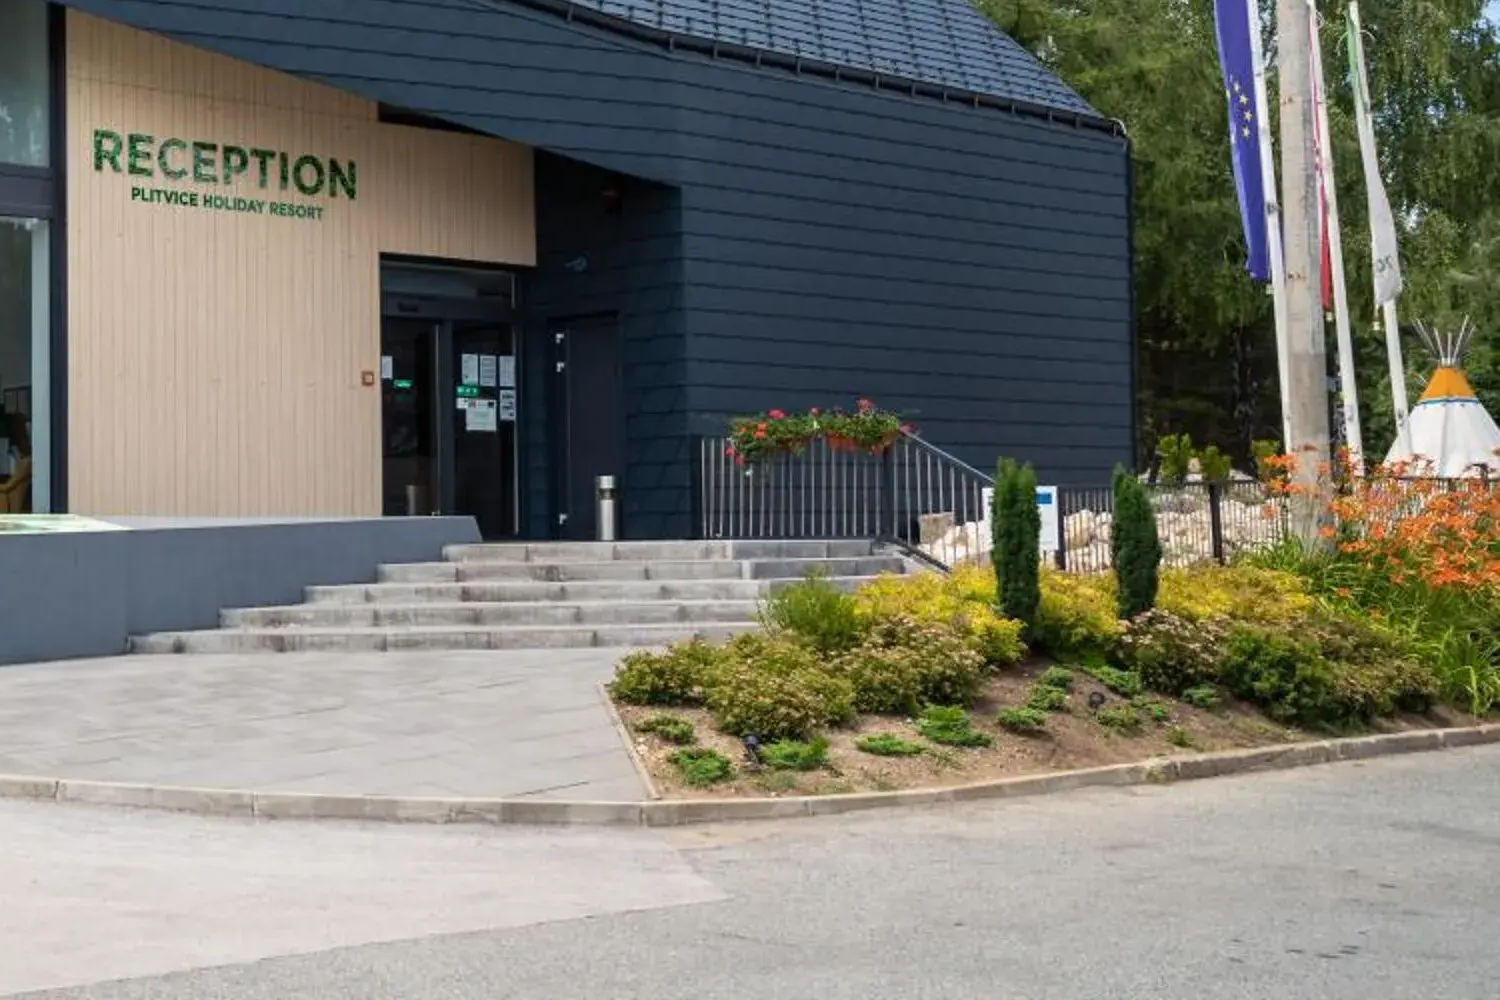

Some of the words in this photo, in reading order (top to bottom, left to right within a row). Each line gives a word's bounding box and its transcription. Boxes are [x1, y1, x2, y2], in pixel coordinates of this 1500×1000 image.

[93, 129, 357, 200] RECEPTION
[131, 187, 198, 207] PLITVICE
[203, 195, 266, 215] HOLIDAY
[269, 202, 325, 220] RESORT
